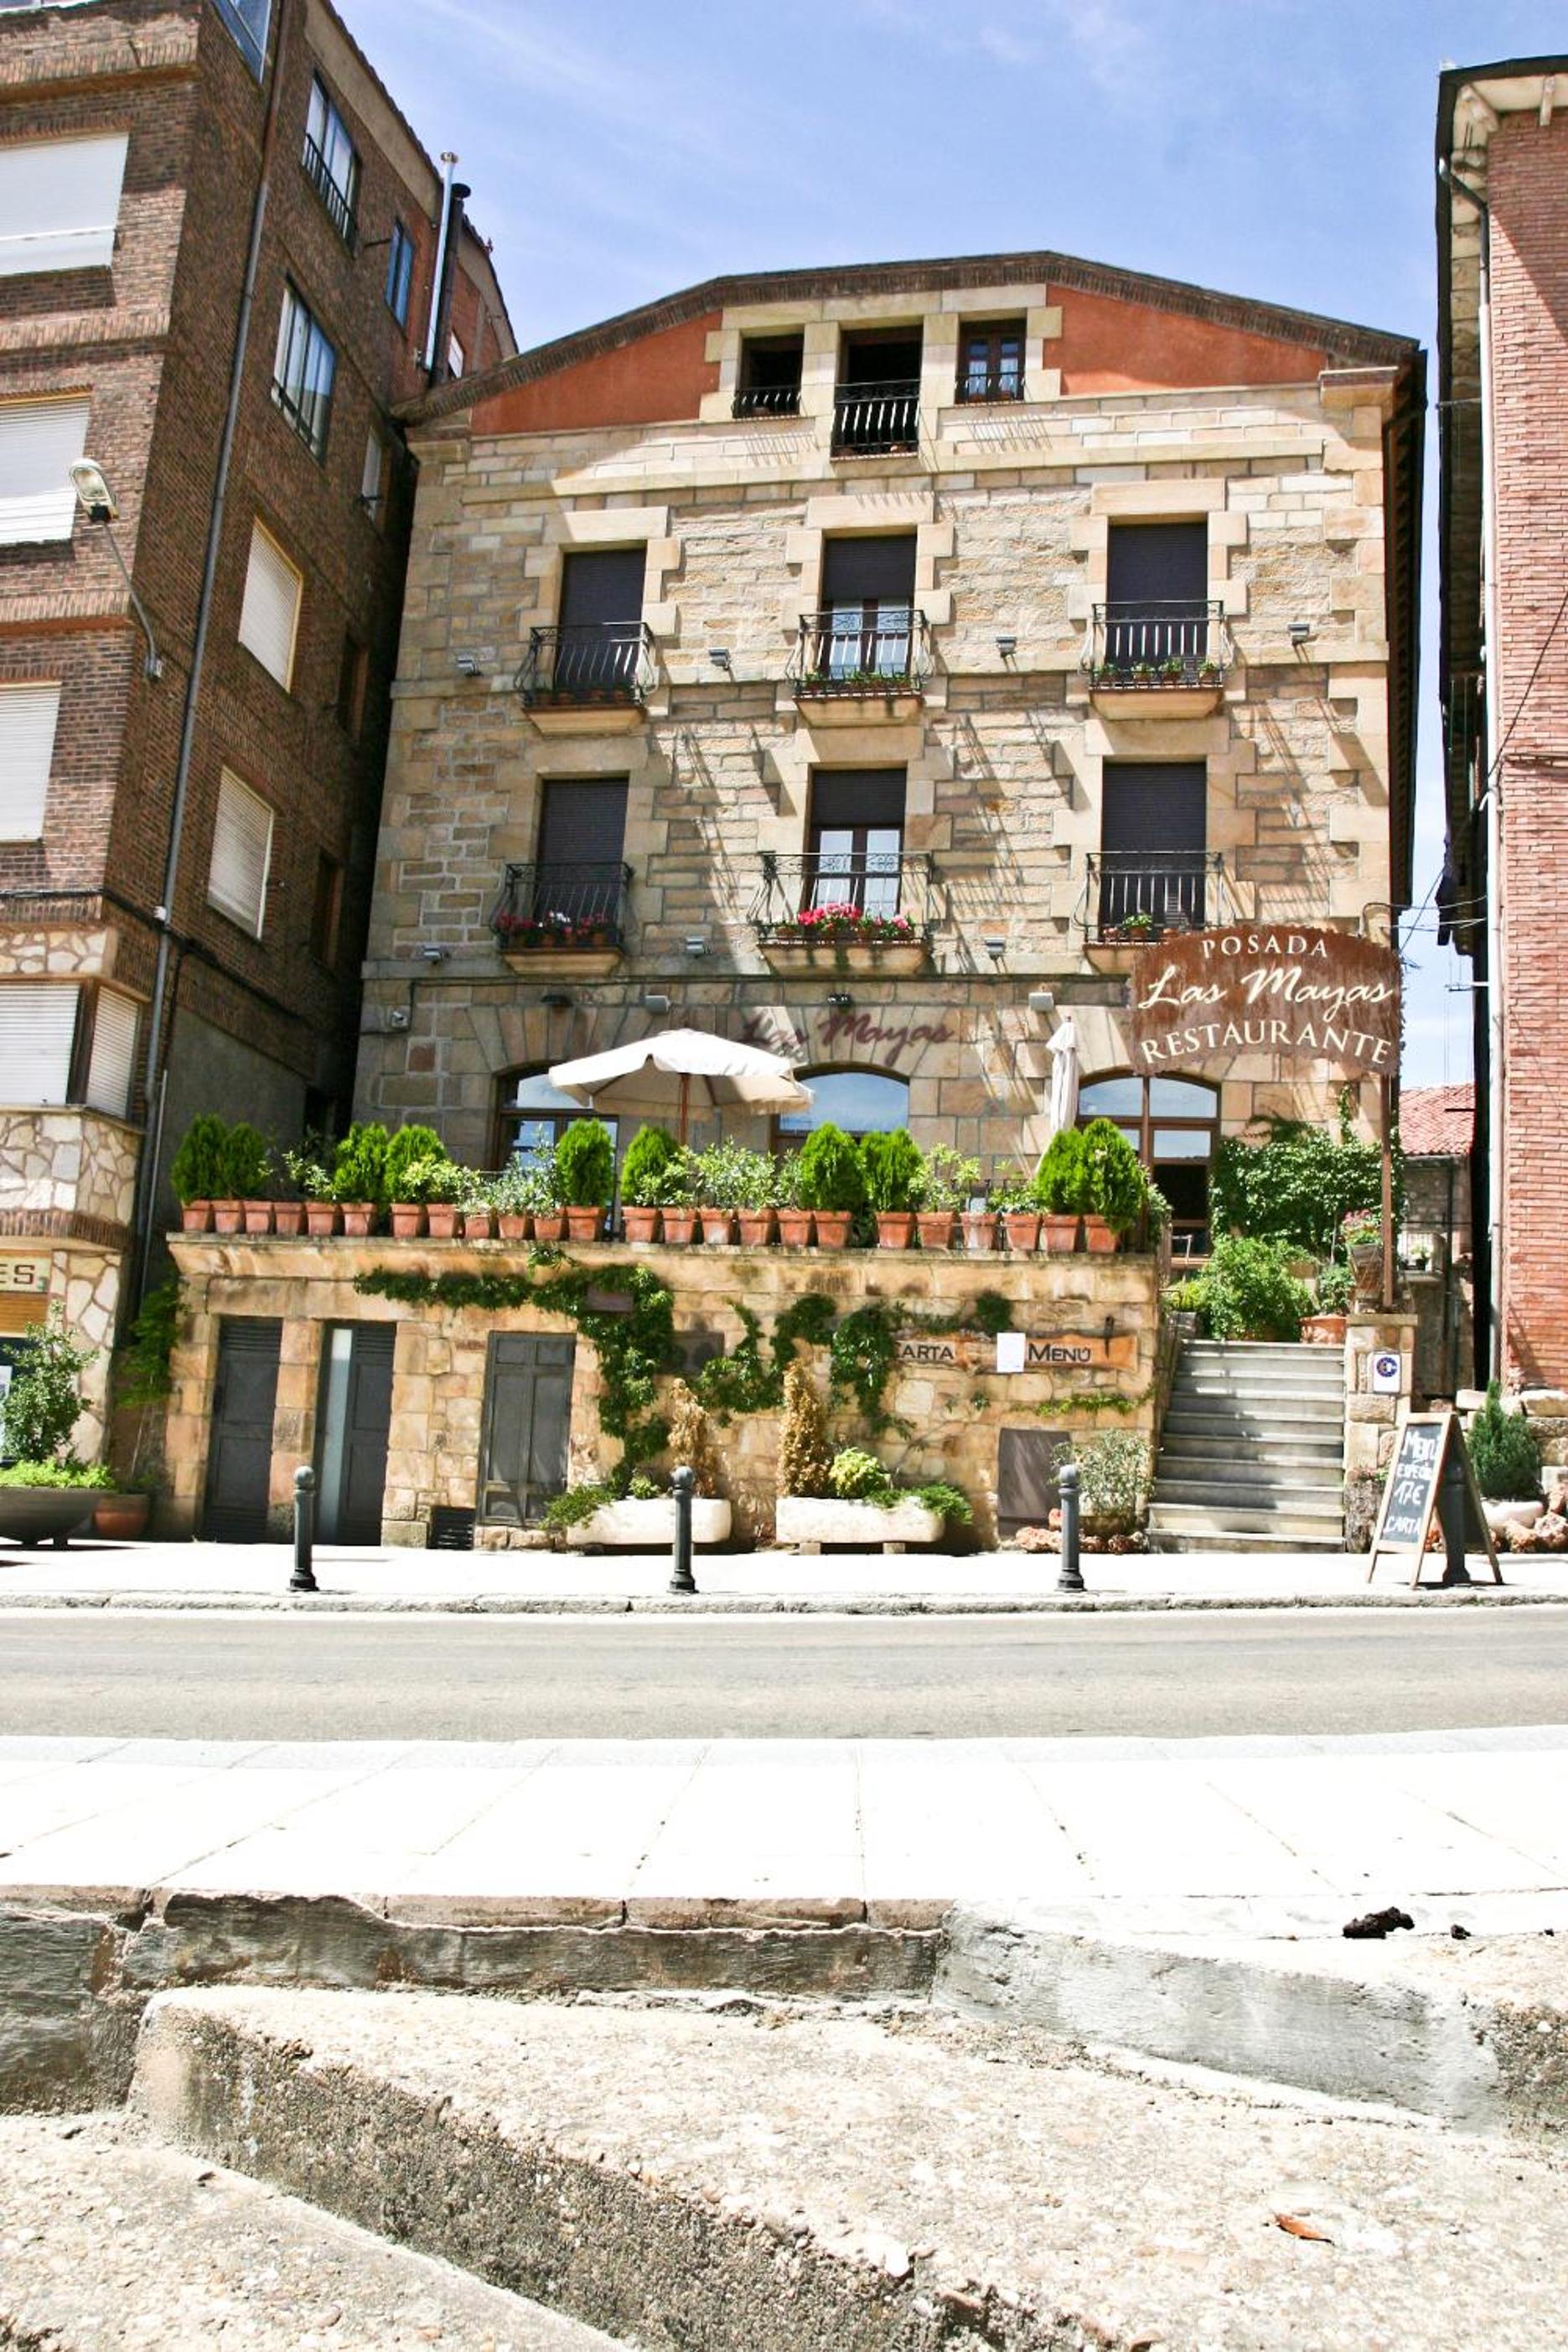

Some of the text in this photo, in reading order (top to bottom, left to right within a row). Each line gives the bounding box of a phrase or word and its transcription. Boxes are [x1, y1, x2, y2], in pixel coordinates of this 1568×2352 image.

[1203, 934, 1327, 959] POSADA
[1138, 964, 1394, 1023] Las Mayas
[817, 1013, 955, 1068] Mayas
[1141, 1019, 1392, 1065] RESTAURANTE
